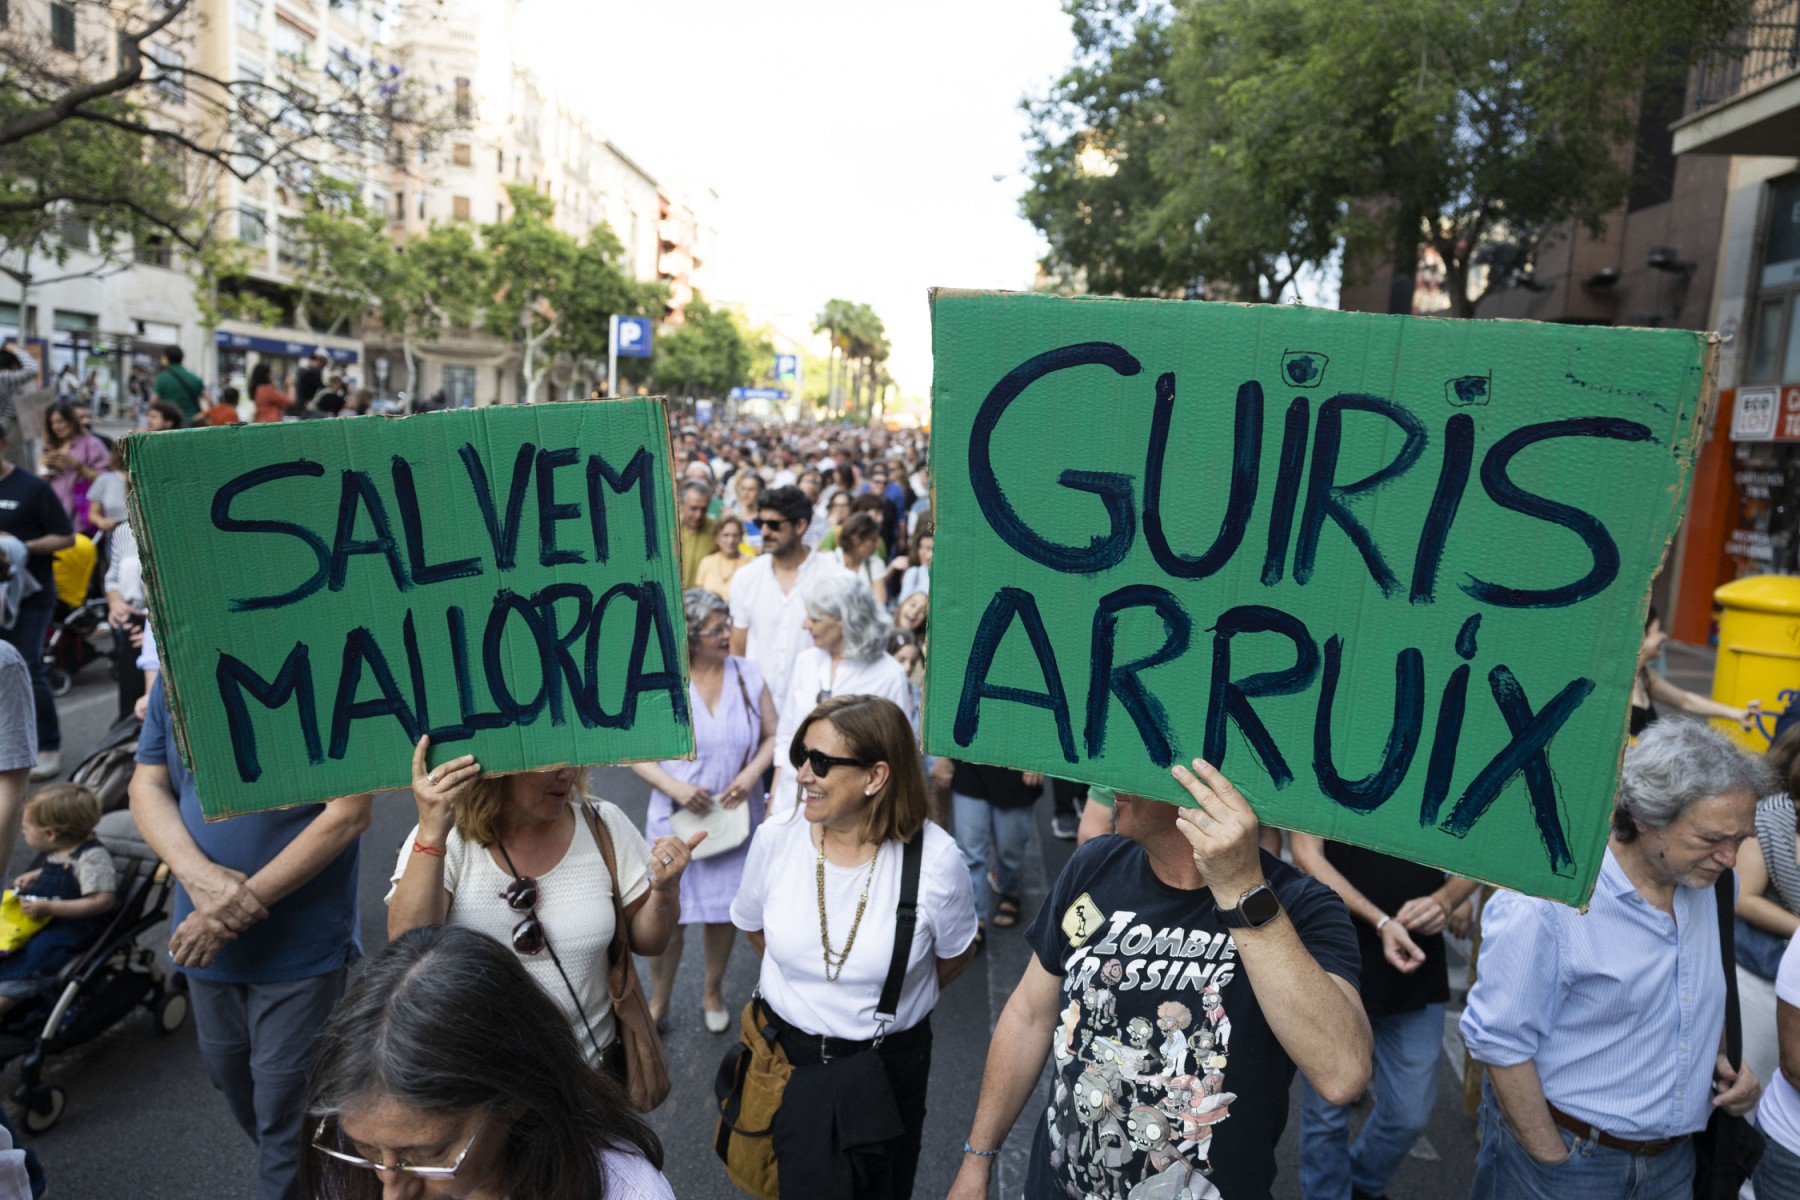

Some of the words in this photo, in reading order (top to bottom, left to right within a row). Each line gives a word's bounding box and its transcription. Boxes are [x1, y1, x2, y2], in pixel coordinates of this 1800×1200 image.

[211, 442, 659, 612] SALVEM
[216, 581, 688, 783] MALLORCA
[1093, 910, 1238, 960] ZOMBIE
